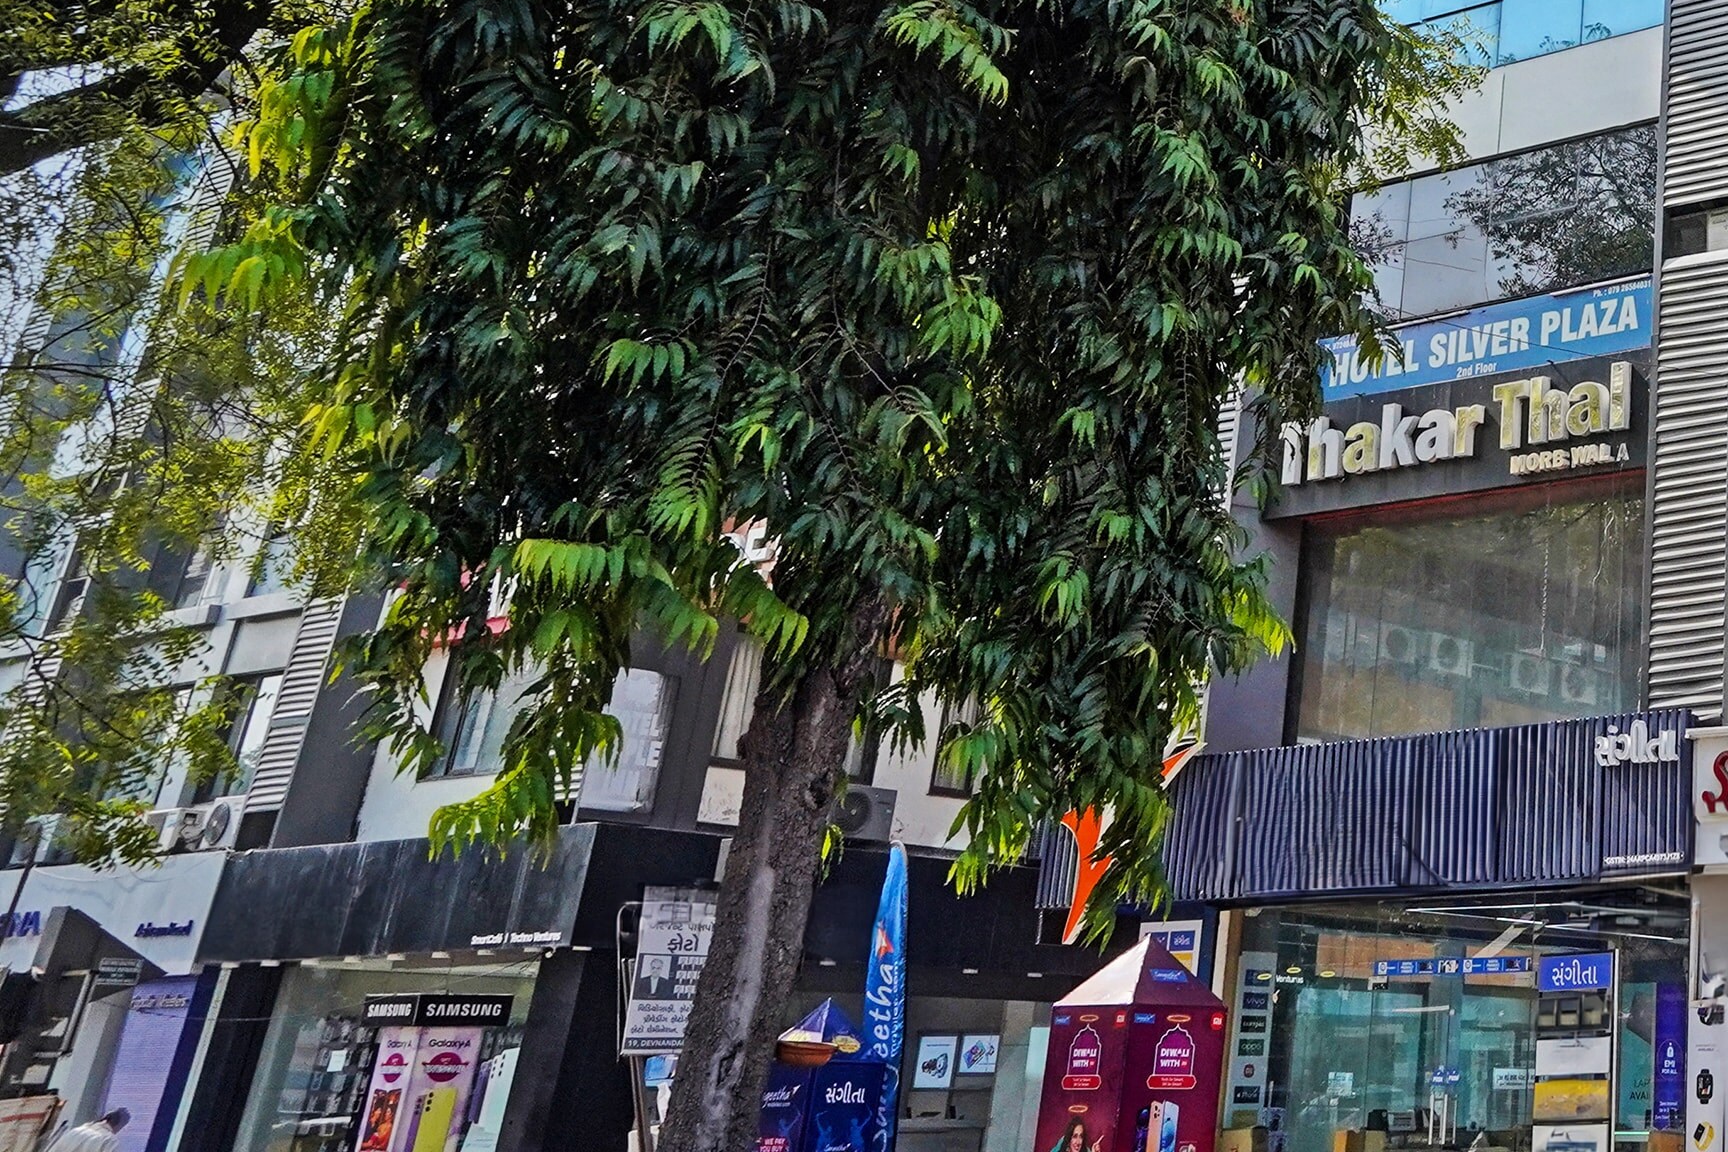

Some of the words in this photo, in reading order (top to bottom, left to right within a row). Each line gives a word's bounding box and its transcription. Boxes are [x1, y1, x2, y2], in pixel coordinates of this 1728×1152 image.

[1428, 316, 1530, 369] SILVER
[1540, 295, 1639, 347] PLAZA
[1456, 365, 1473, 379] 2nd
[1473, 361, 1497, 376] Floor
[1493, 360, 1632, 450] Thal
[1551, 958, 1598, 986] સંગીતા
[367, 1003, 412, 1018] SAMSUNG
[426, 1003, 502, 1017] SAMSUNG
[1160, 1048, 1190, 1058] DIWALI
[1160, 1059, 1181, 1068] WITH
[825, 1081, 866, 1104] સંગીતા
